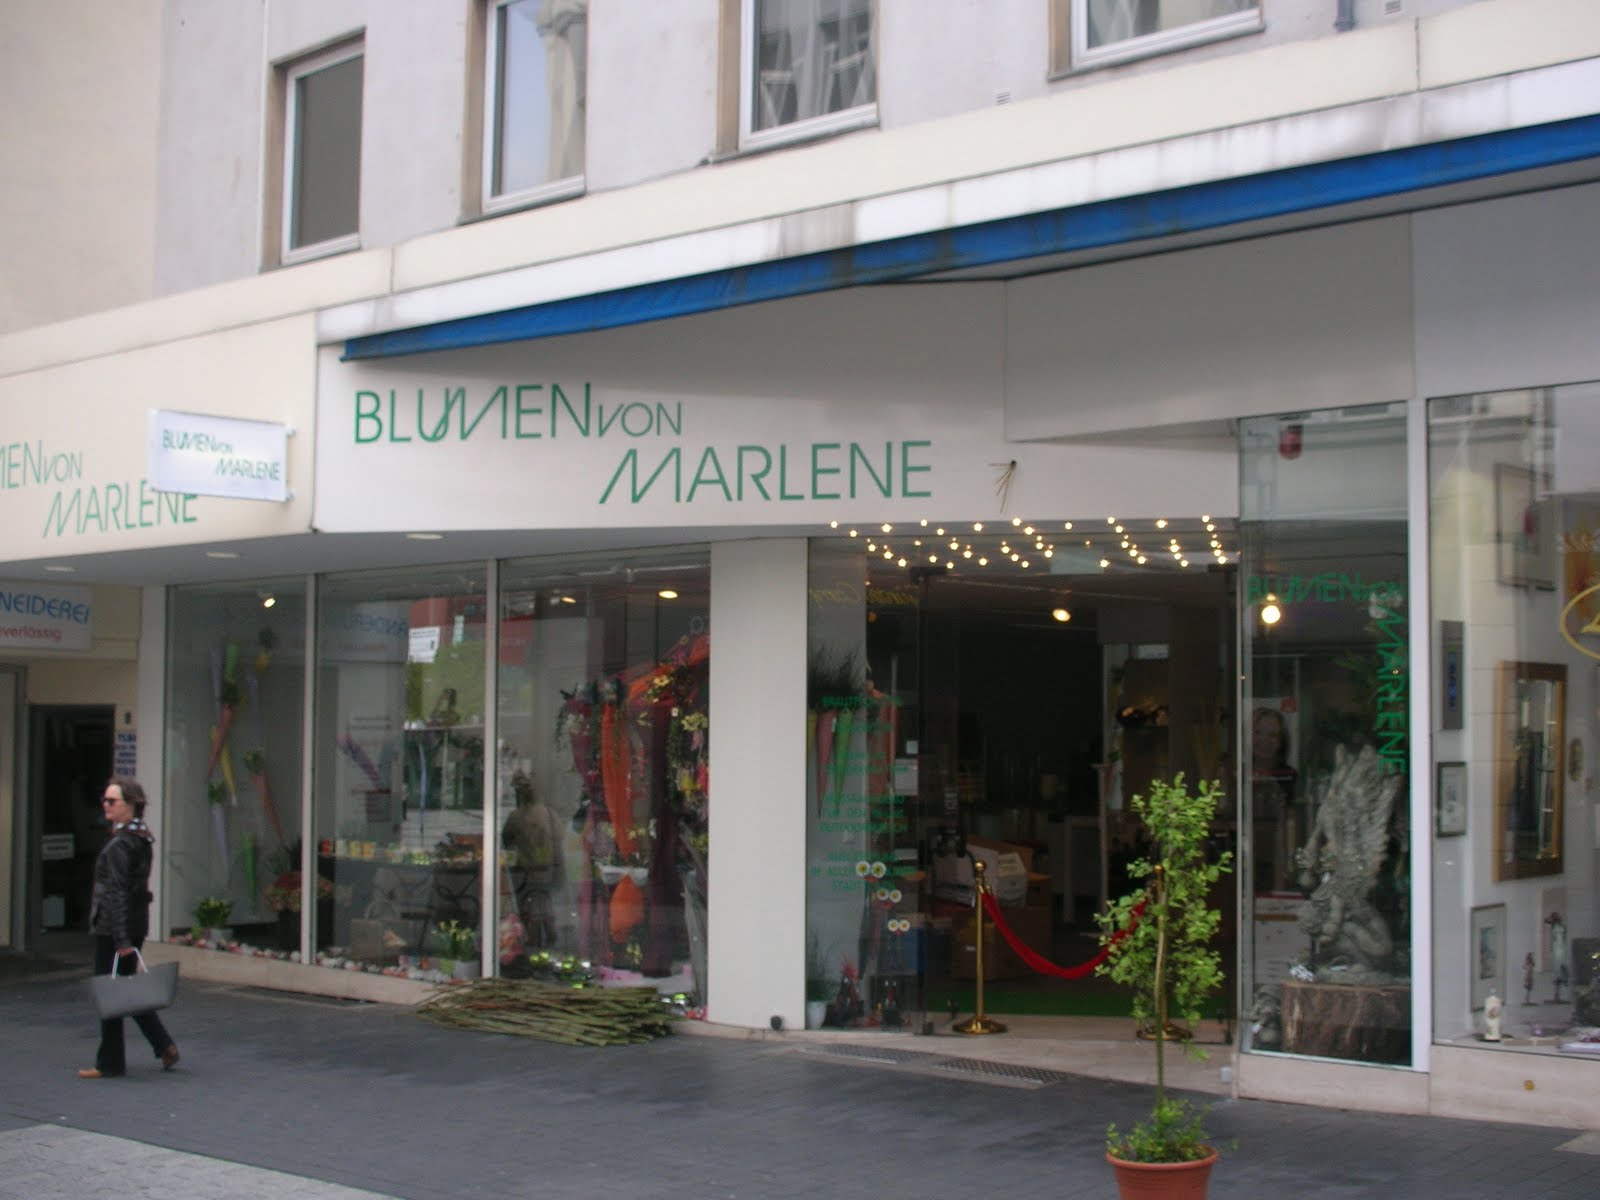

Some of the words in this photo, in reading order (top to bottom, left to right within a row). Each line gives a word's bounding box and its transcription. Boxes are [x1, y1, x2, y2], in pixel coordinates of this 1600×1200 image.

[353, 381, 591, 444] BLUMEN
[215, 458, 281, 480] MARLENE
[598, 440, 932, 505] MARLENE
[42, 480, 199, 539] MARLENE
[1376, 603, 1407, 775] MARLENE
